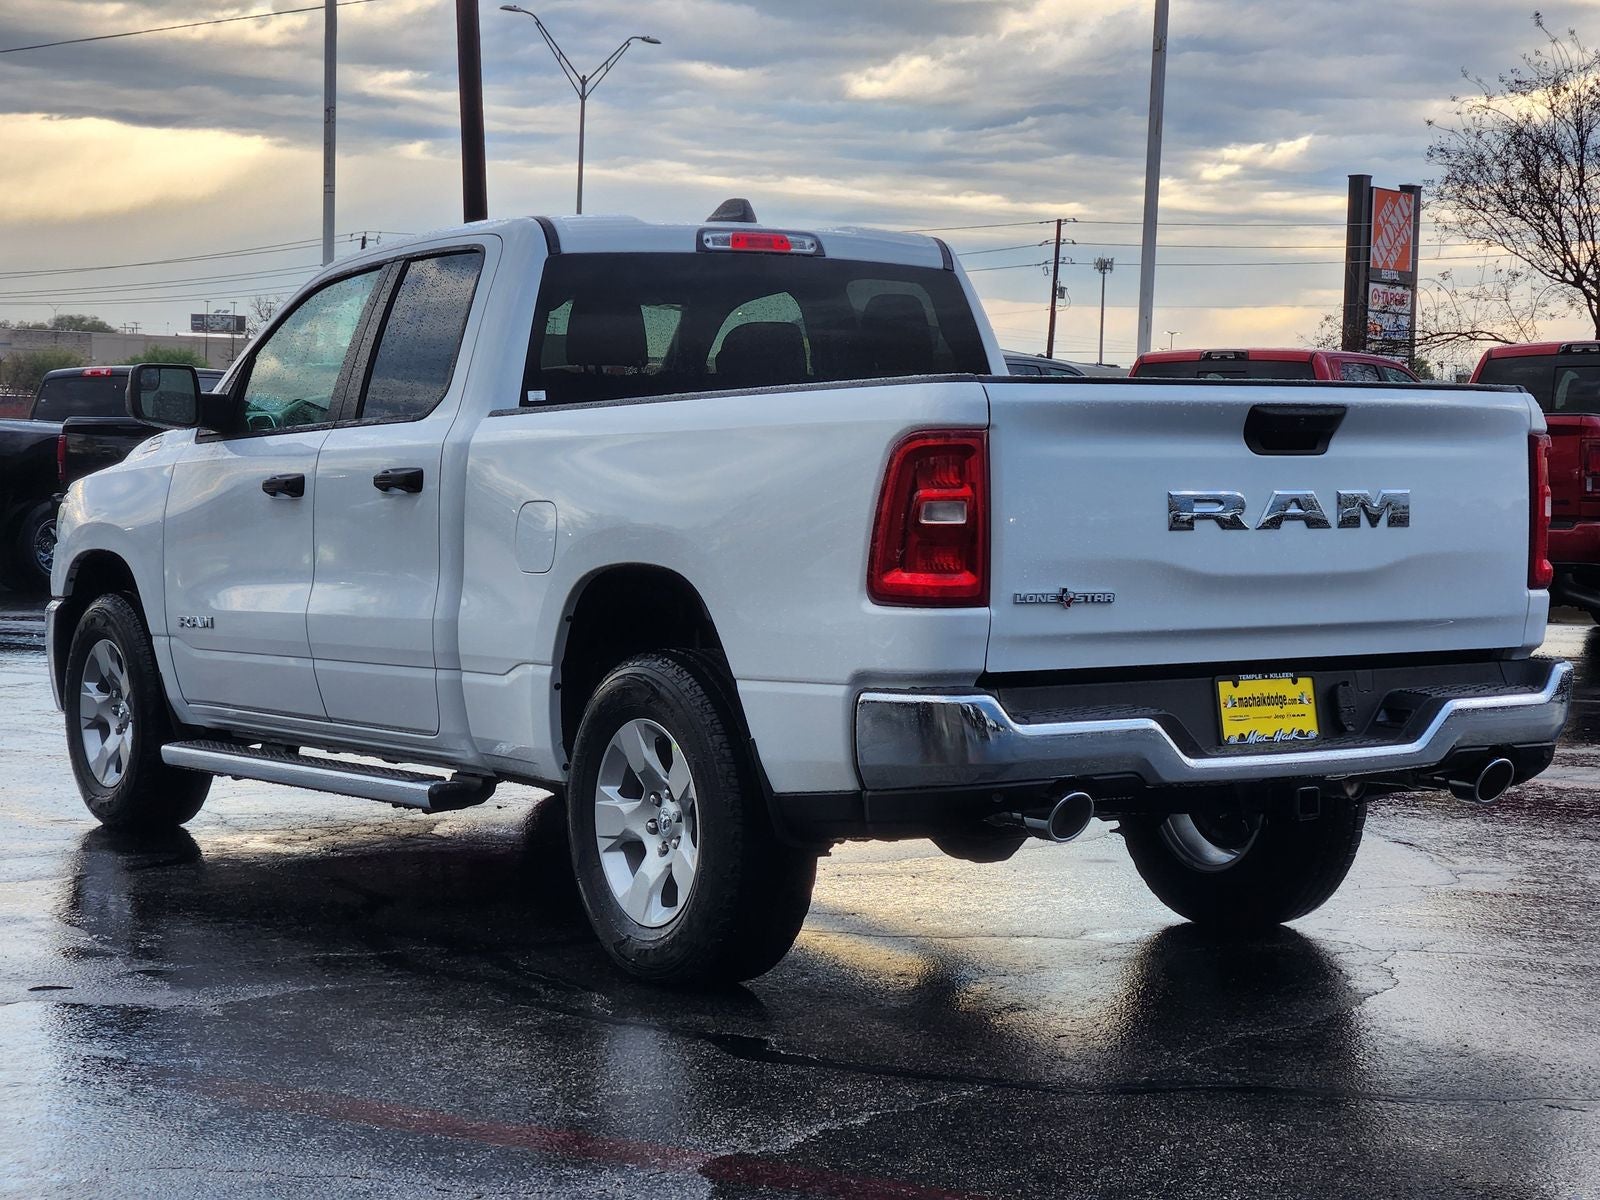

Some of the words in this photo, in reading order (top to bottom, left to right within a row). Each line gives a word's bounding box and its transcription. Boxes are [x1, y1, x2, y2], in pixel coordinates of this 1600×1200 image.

[1378, 197, 1394, 229] THE
[1372, 193, 1412, 268] HOME
[1387, 220, 1412, 269] DEPOT
[1380, 291, 1409, 306] TARGET
[1168, 489, 1411, 531] RAM
[1013, 593, 1057, 604] LONE
[1073, 592, 1116, 603] STAR
[177, 615, 215, 629] RAM
[1238, 692, 1298, 709] machaikdodge.com
[1247, 729, 1268, 744] Mac
[1273, 727, 1299, 743] Haik
